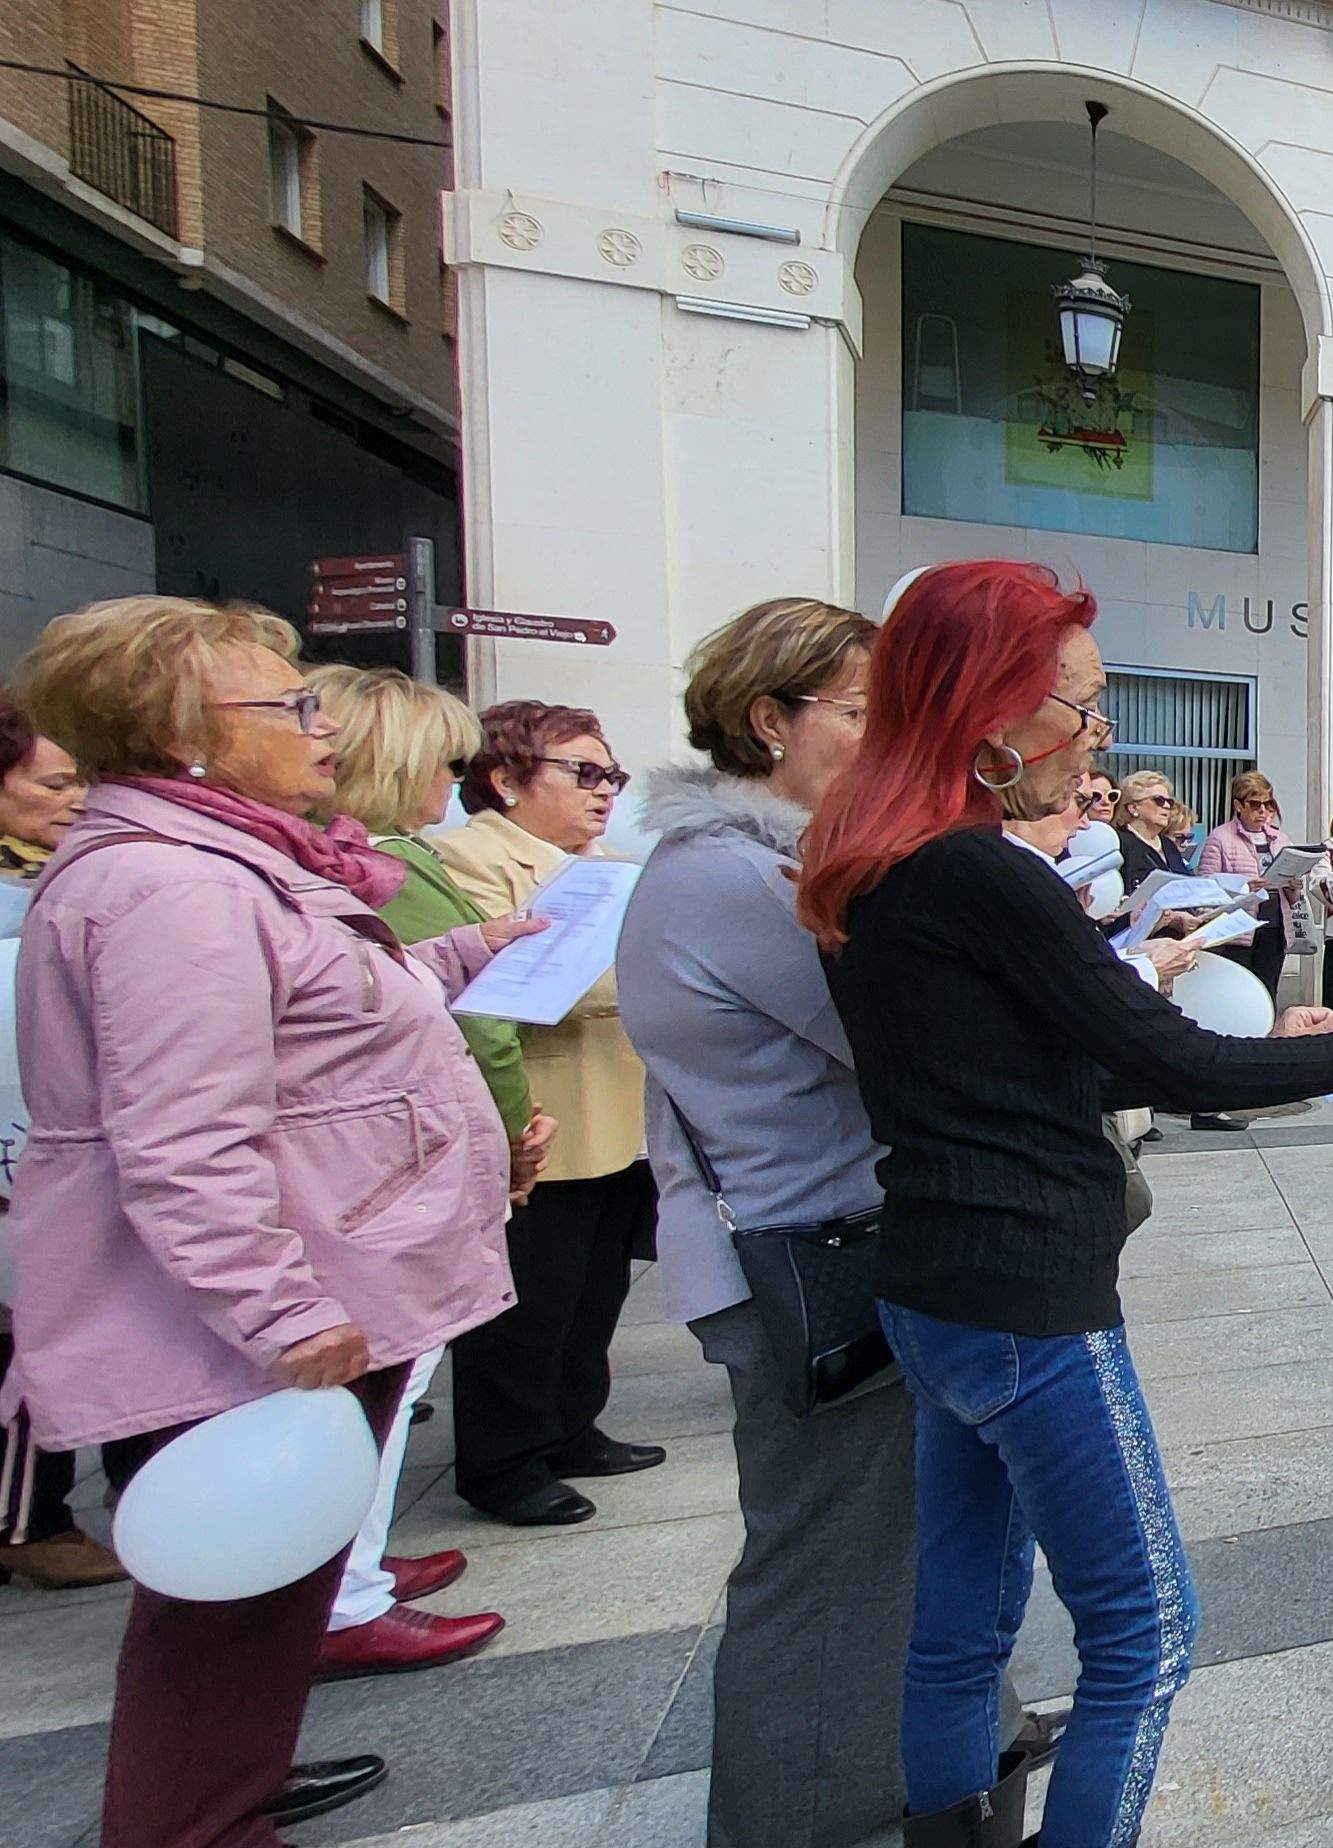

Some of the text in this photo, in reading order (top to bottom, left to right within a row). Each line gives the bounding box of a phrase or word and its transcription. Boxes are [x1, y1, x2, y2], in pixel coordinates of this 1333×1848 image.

[472, 613, 504, 625] Iglesia
[505, 616, 513, 626] y
[472, 623, 575, 639] de San Pedro el Viejo
